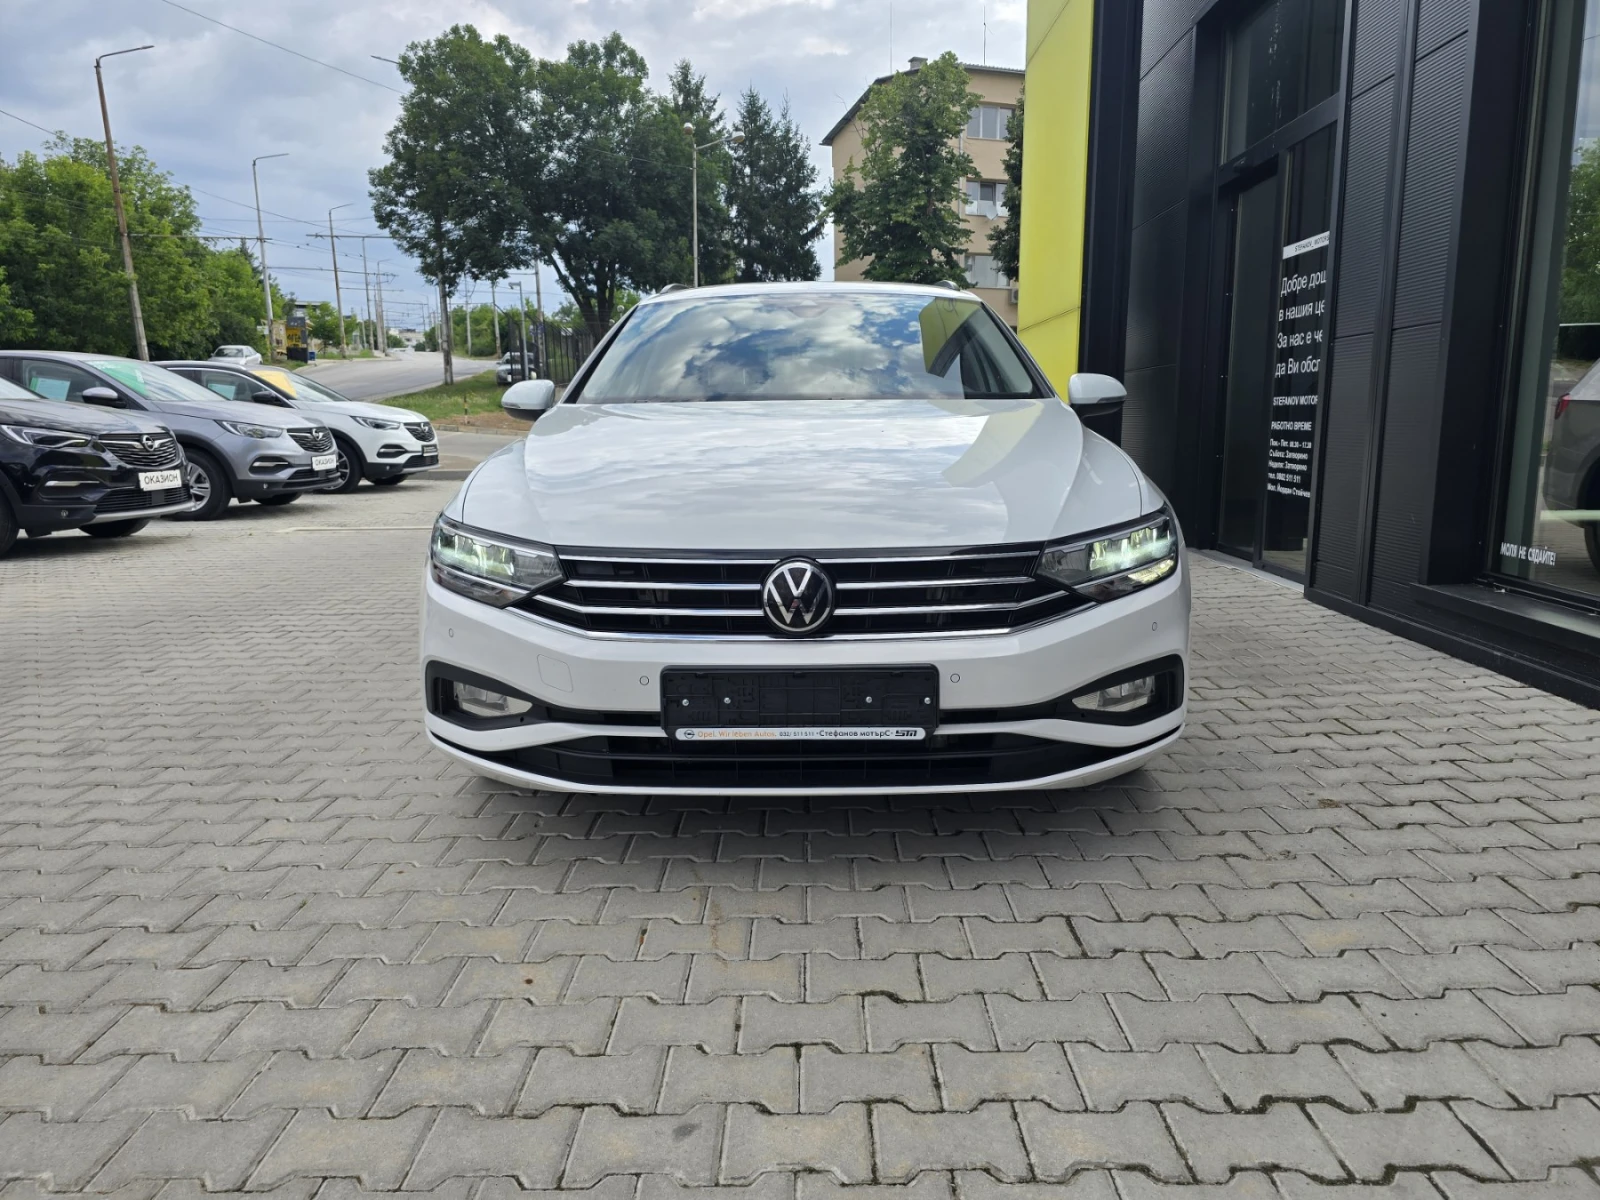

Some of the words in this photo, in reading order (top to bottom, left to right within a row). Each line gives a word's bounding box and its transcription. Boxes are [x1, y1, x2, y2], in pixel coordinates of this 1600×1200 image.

[1280, 273, 1308, 297] Добре
[1278, 309, 1284, 322] в
[1285, 302, 1314, 320] нашия
[1276, 332, 1287, 348] За
[1289, 332, 1305, 347] нас
[1306, 331, 1312, 344] е
[1274, 362, 1286, 378] да
[1288, 357, 1299, 374] Ви
[1273, 396, 1299, 406] STEFANOV
[1270, 421, 1294, 430] РАБОТНО
[1294, 421, 1312, 431] ВРЕМЕ
[144, 473, 179, 485] ОКАЗИОН
[1500, 541, 1518, 558] МОЛЯ
[1518, 545, 1527, 560] НЕ
[819, 729, 859, 738] Стефанов
